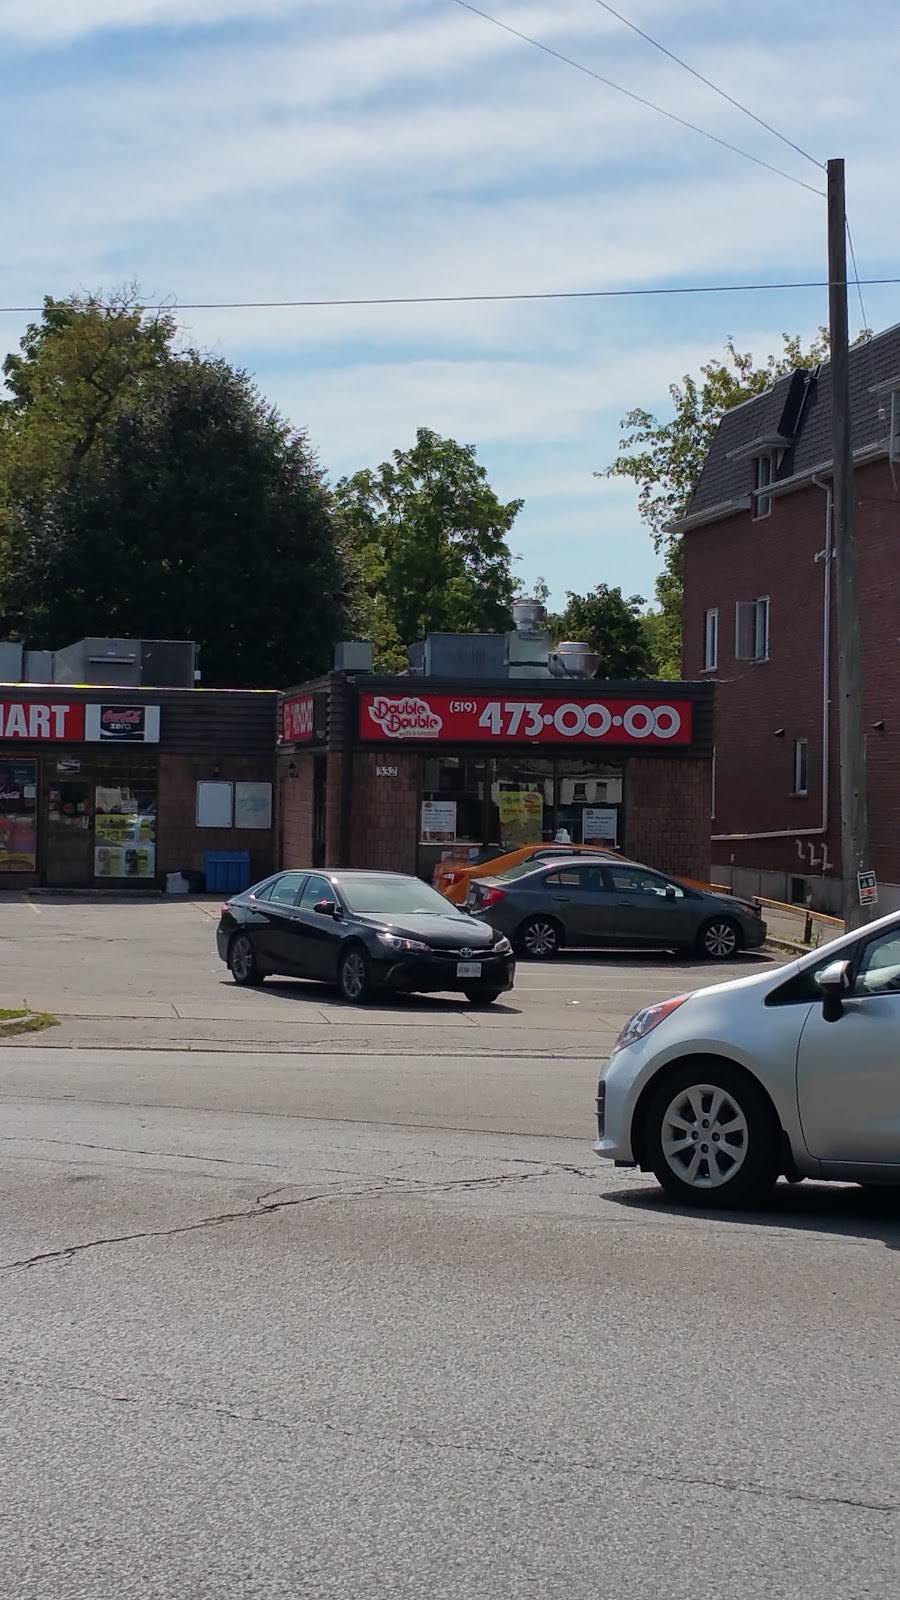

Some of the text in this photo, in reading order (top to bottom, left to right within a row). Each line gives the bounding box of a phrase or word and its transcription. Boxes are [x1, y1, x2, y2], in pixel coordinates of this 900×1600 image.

[373, 701, 426, 719] Double
[449, 701, 477, 714] (519)
[0, 703, 70, 738] ART
[386, 715, 439, 732] Double
